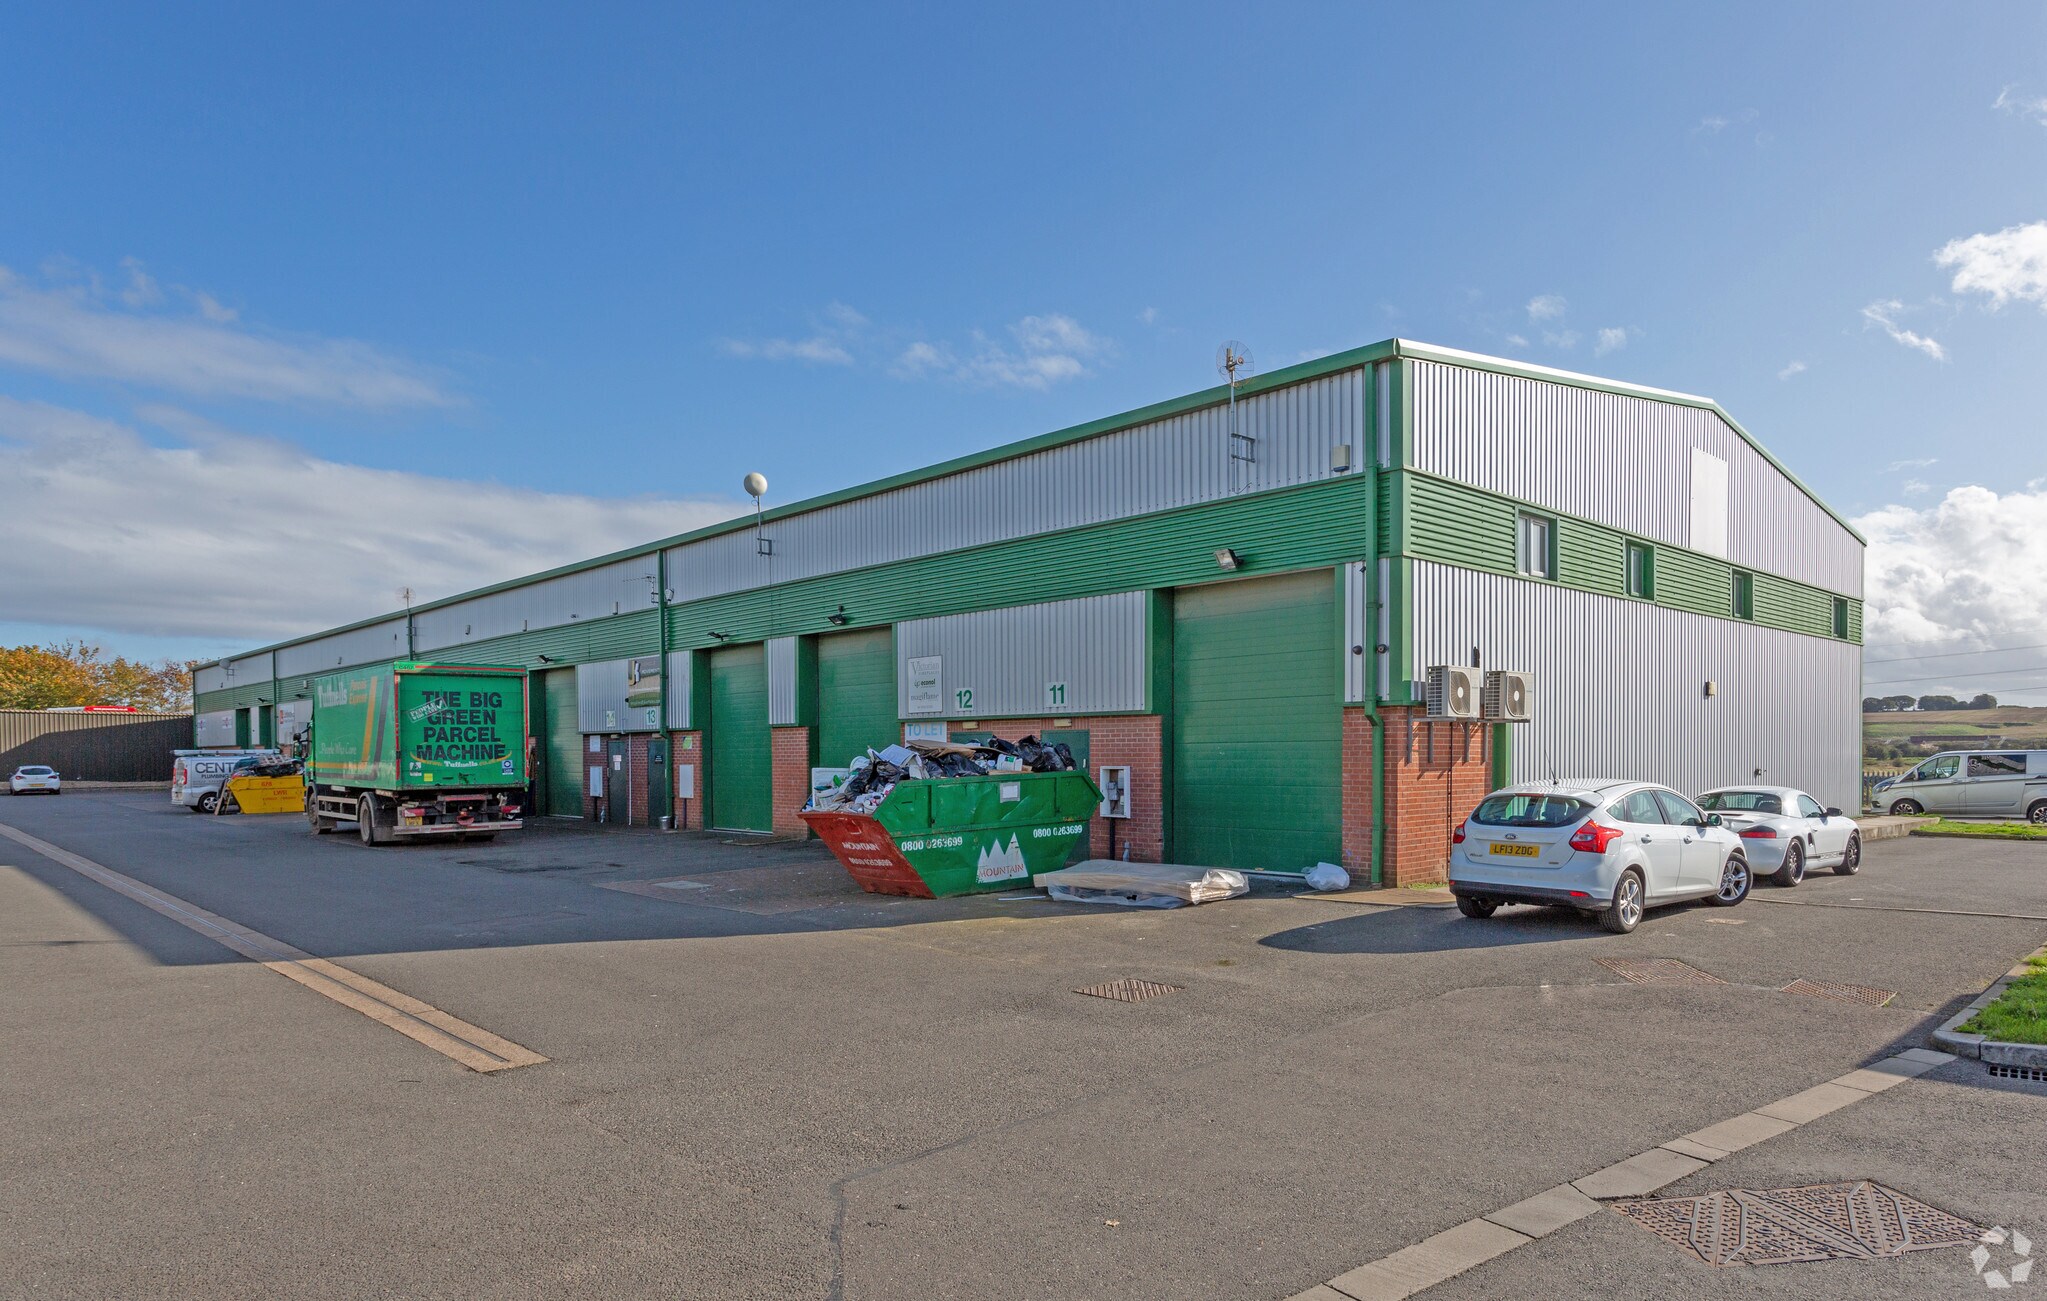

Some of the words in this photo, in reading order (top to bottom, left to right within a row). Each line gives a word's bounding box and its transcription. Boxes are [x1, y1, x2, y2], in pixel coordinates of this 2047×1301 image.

[422, 691, 461, 708] THE
[470, 691, 502, 709] BIG
[956, 689, 973, 709] 12
[1049, 684, 1065, 704] 11
[427, 709, 497, 725] GREEN
[646, 709, 656, 723] 13
[424, 727, 501, 743] PARCEL
[907, 723, 921, 737] TO
[924, 722, 943, 736] LET
[416, 744, 506, 761] MACHINE
[195, 762, 235, 774] CENT
[1033, 828, 1051, 838] 0800
[1053, 824, 1083, 836] 0263699
[901, 840, 924, 851] 0800
[1494, 845, 1513, 854] LF13
[1515, 846, 1533, 855] ZDG
